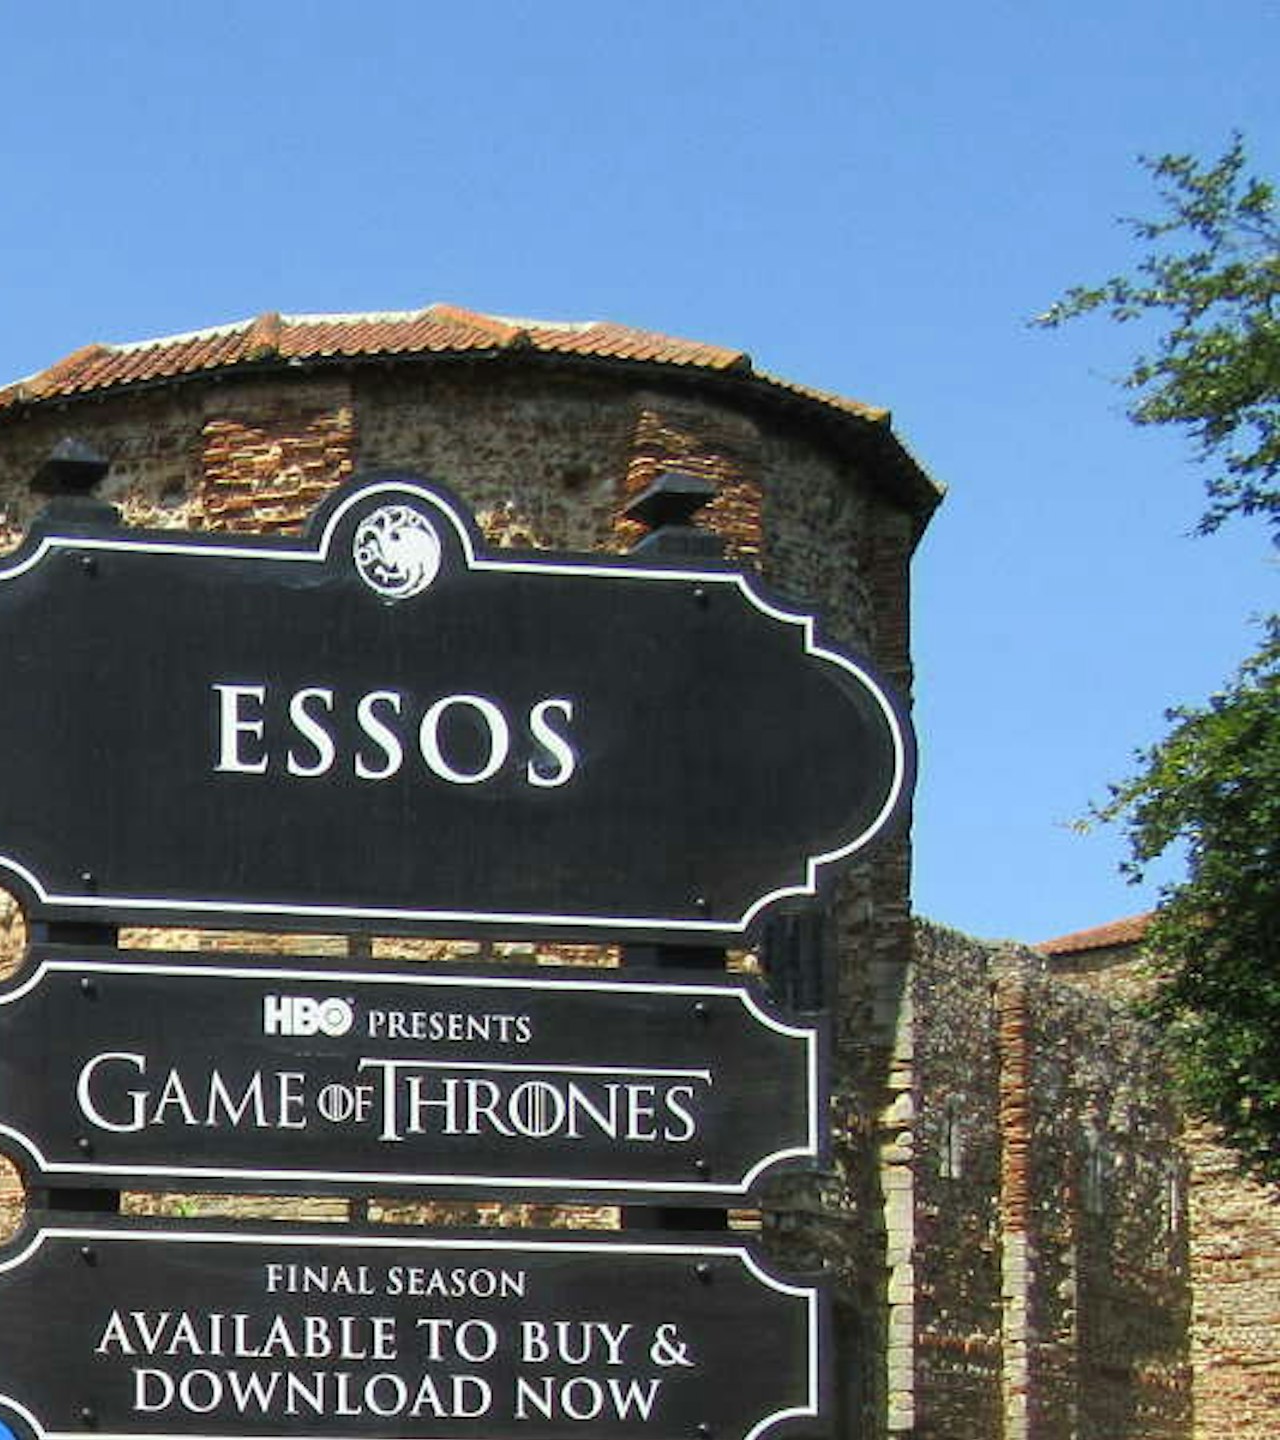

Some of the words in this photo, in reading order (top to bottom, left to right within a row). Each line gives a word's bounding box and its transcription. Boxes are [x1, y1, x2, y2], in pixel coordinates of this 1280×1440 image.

[212, 684, 576, 788] ESSOS
[264, 995, 354, 1036] HBO
[368, 1010, 532, 1043] PRESENTS
[76, 1052, 307, 1133] GAME
[317, 1083, 373, 1122] OF
[358, 1057, 712, 1142] THRONES
[266, 1263, 375, 1295] FINAL
[386, 1266, 526, 1298] SEASON
[94, 1309, 398, 1362] AVAILABLE
[416, 1318, 498, 1362] TO
[520, 1321, 633, 1365] BUY
[650, 1323, 695, 1367] &
[133, 1367, 492, 1418] DOWNLOAD
[515, 1376, 662, 1421] NOW
